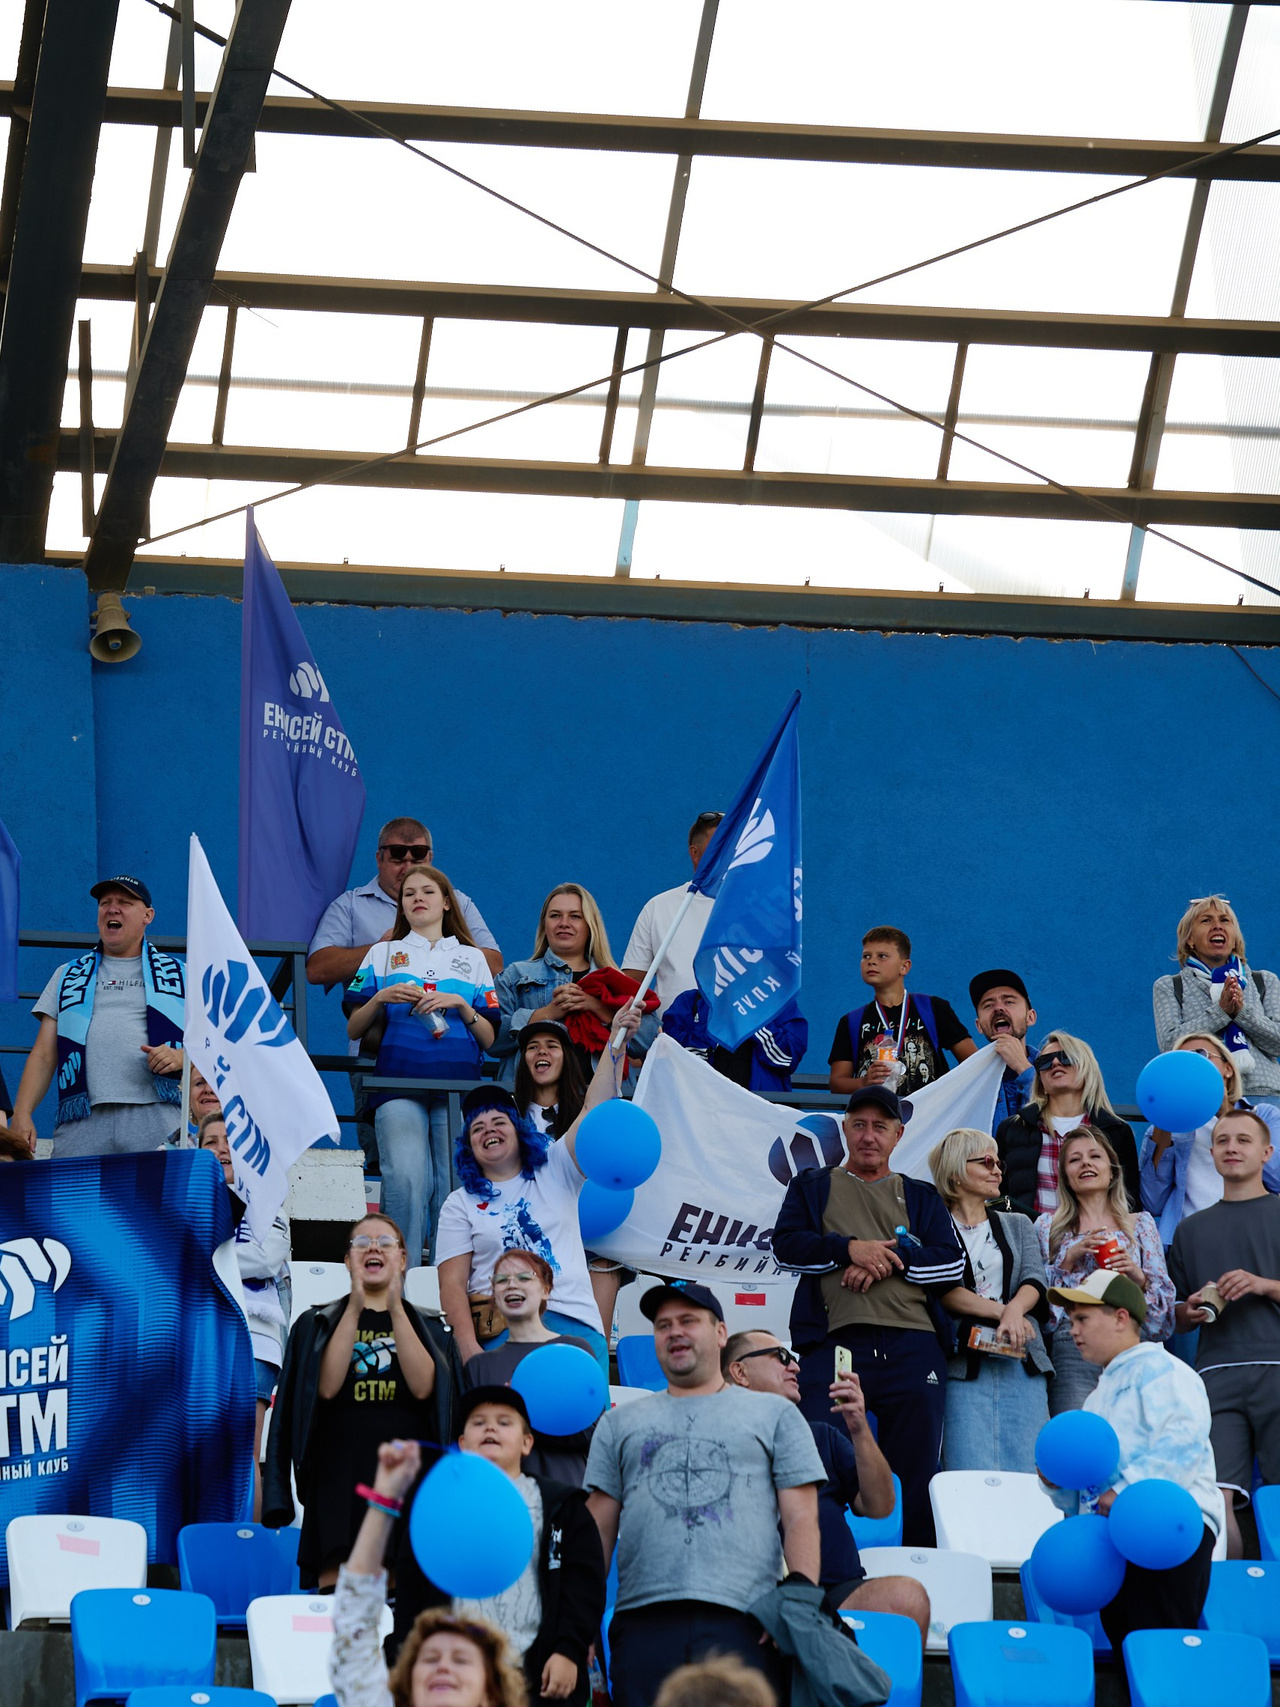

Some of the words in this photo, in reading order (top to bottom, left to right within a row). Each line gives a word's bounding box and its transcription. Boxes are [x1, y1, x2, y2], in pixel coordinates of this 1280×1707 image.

[331, 755, 358, 777] КЛУБ
[119, 979, 146, 988] HILFI
[222, 1094, 271, 1177] СТМ
[354, 1380, 396, 1402] СТМ
[37, 1456, 69, 1476] КЛУБ
